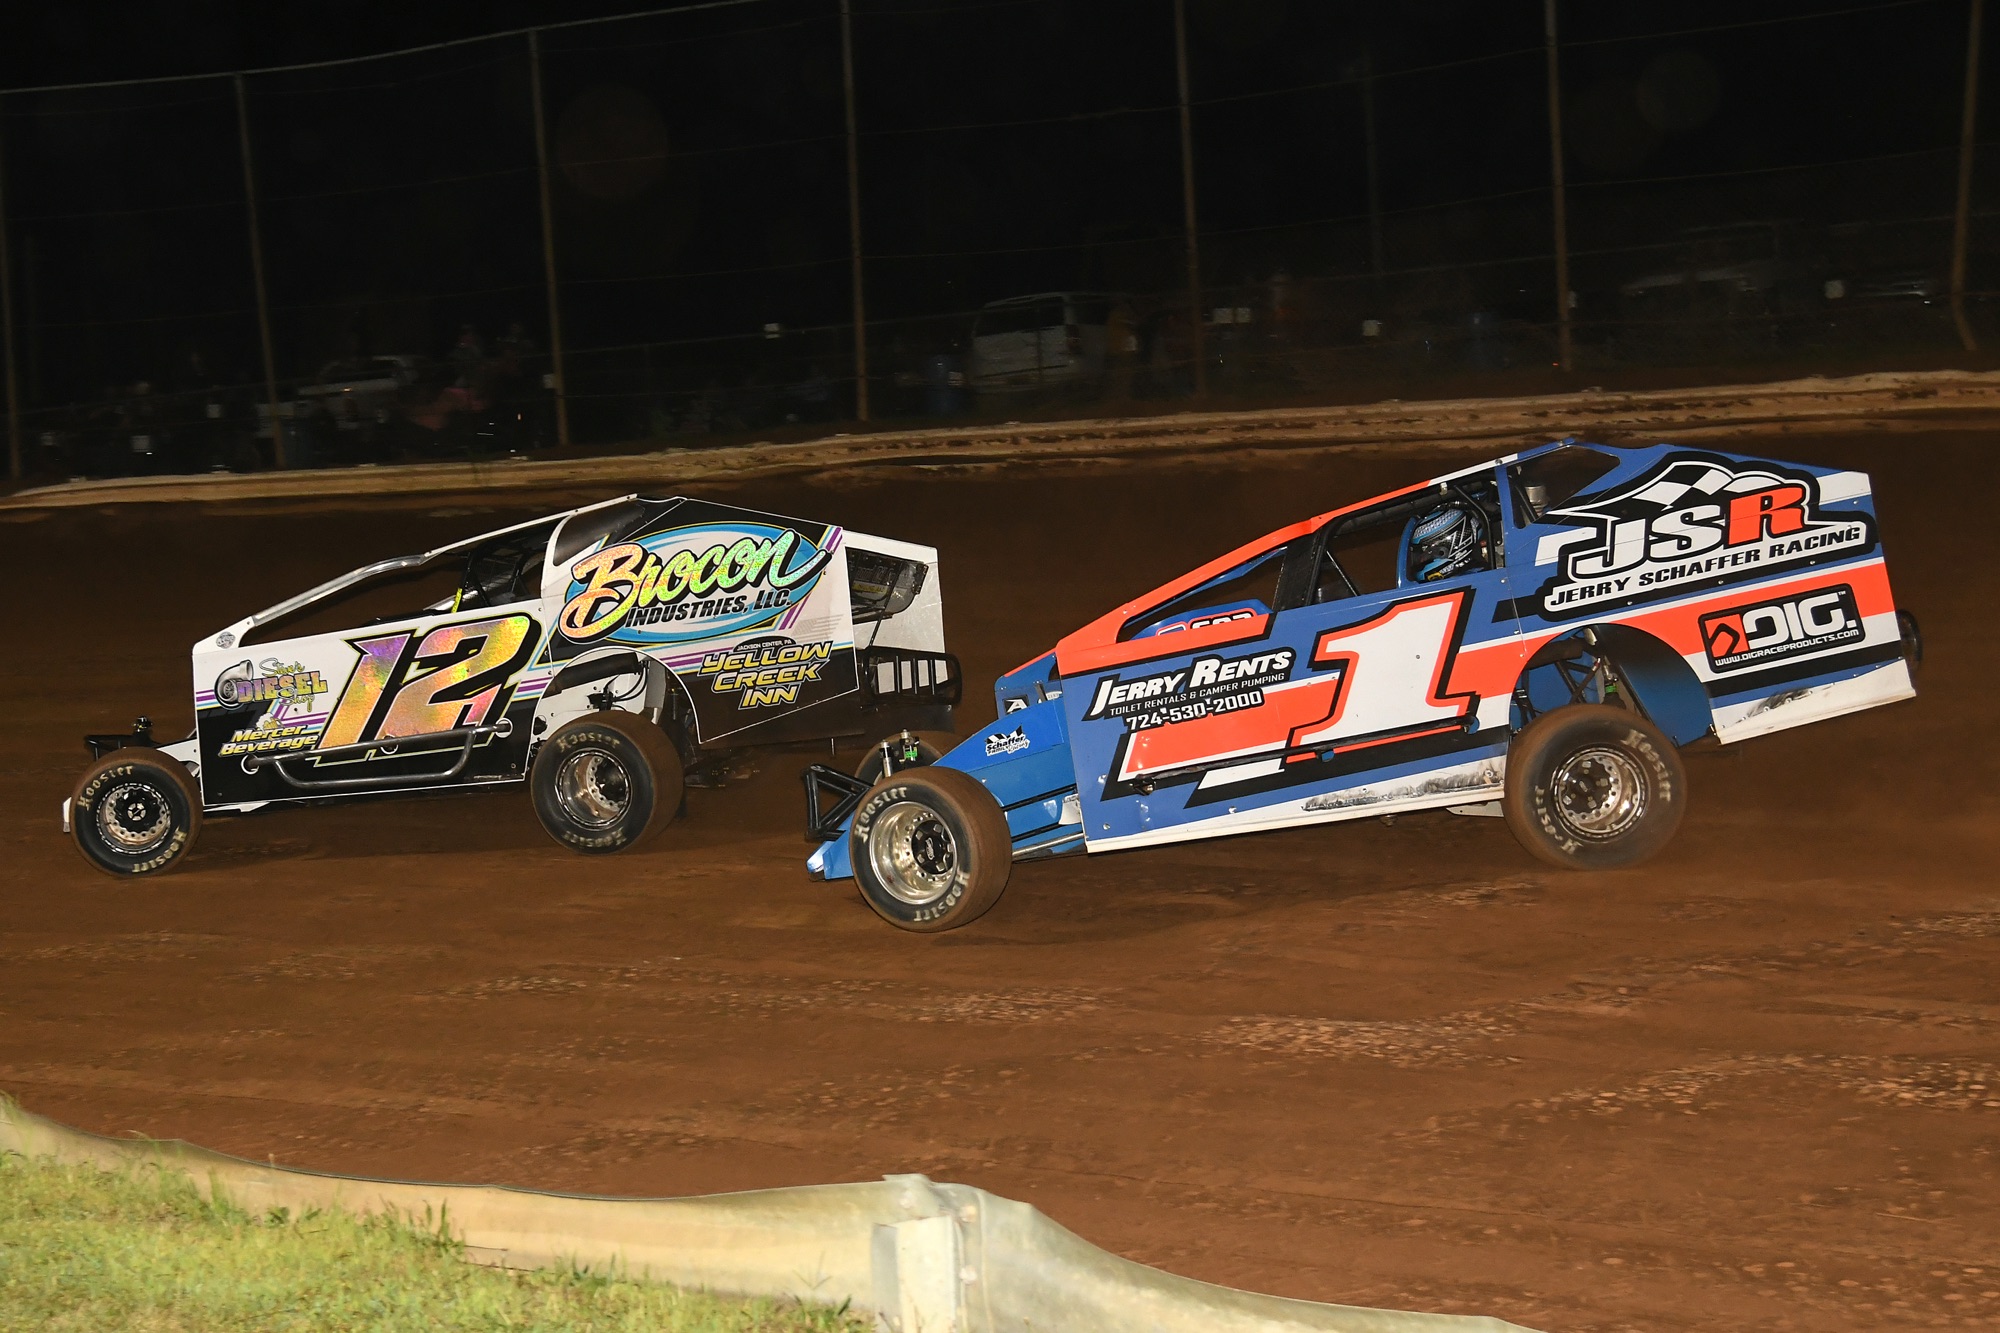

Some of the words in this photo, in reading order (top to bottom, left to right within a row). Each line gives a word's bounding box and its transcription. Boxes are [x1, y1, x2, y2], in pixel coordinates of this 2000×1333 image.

[1574, 485, 1805, 576] JSR
[559, 529, 829, 640] Brocon
[1550, 577, 1631, 606] JERRY
[1638, 548, 1761, 586] SCHAFFER
[1768, 526, 1860, 559] RACING
[624, 594, 748, 628] INDUSTRIES,
[752, 588, 791, 609] LLC.
[700, 642, 832, 674] YELLOW
[736, 642, 761, 651] JACKSON
[236, 670, 329, 703] DIESEL
[316, 614, 536, 758] 12
[713, 663, 822, 692] CREEK
[741, 685, 799, 707] INN
[1089, 672, 1186, 717] JERRY
[1189, 650, 1293, 689] RENTS
[1109, 703, 1143, 717] TOILET
[1144, 693, 1187, 709] RENTALS
[1189, 690, 1196, 700] &
[1199, 682, 1238, 698] CAMPER
[1241, 672, 1285, 691] PUMPING
[1290, 594, 1467, 758] 1
[1126, 690, 1263, 731] 724-530-2000
[219, 734, 319, 756] Beverage
[231, 724, 307, 743] Mercer
[986, 735, 1026, 752] Schaffer
